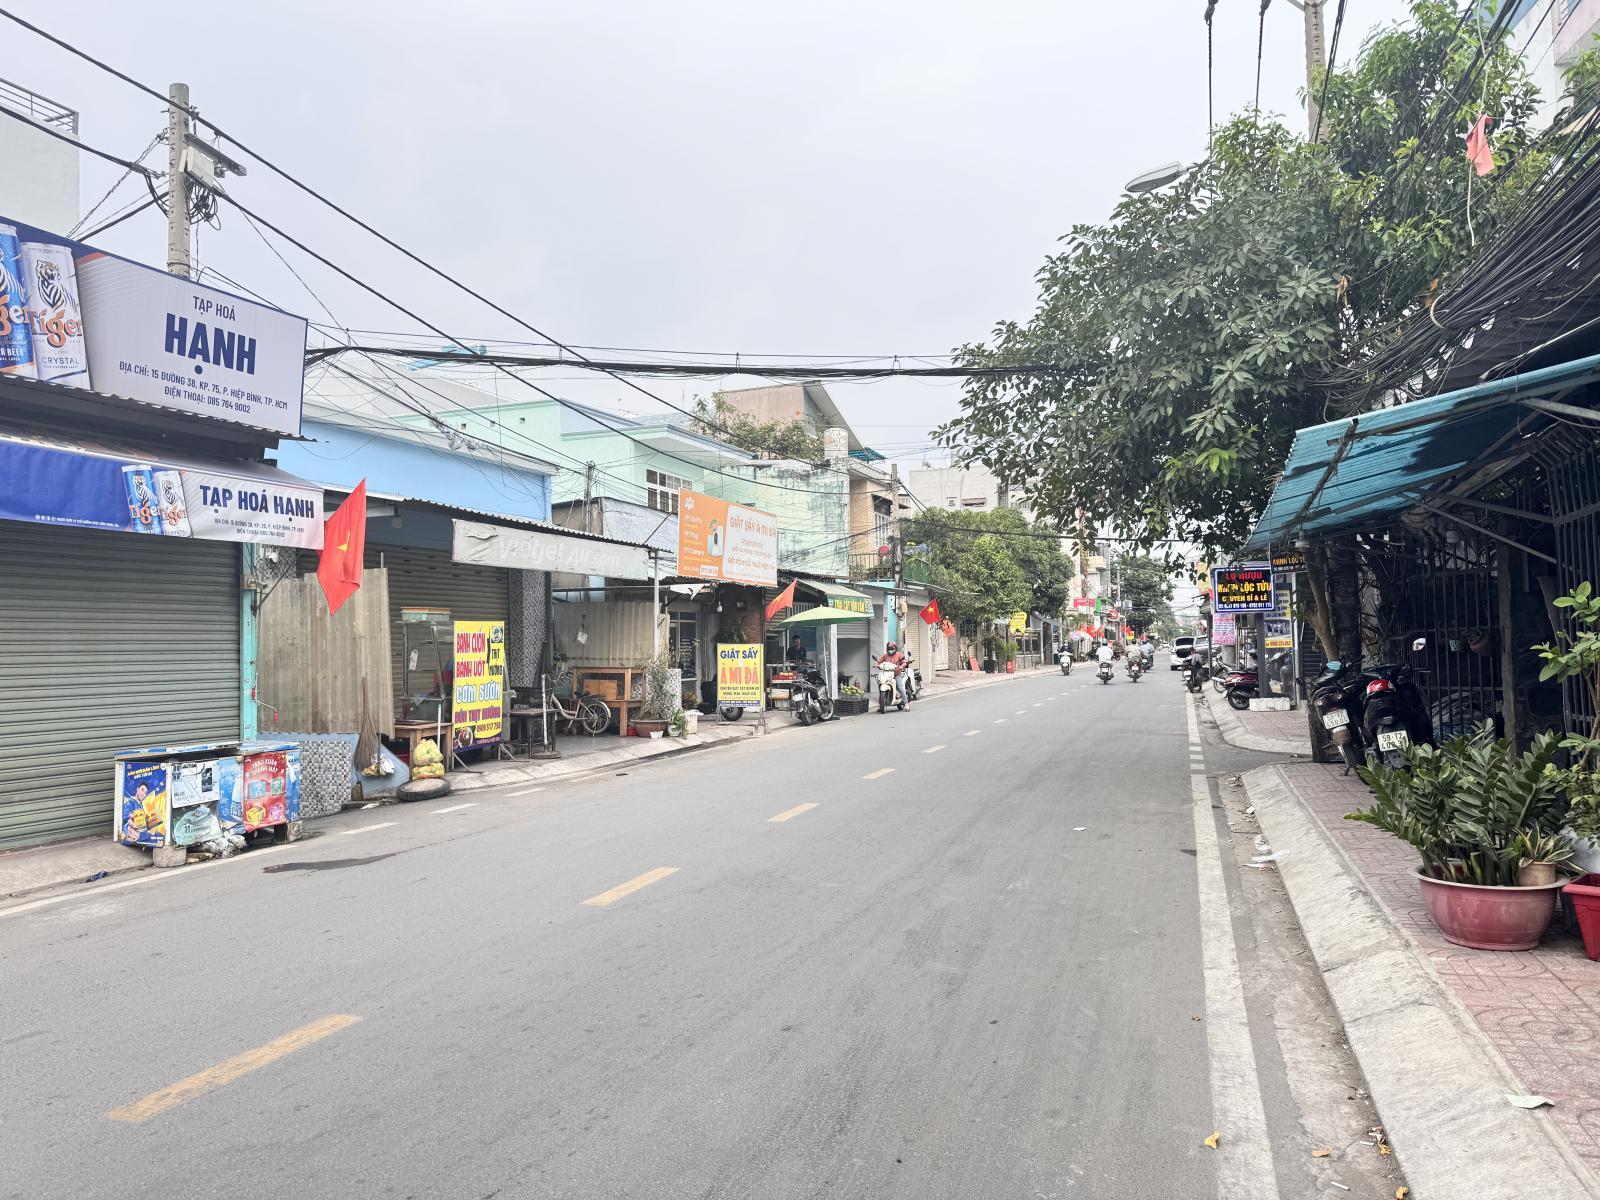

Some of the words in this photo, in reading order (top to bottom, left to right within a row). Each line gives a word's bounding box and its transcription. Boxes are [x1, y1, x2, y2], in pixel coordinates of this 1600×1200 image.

[192, 295, 213, 315] TẠP
[215, 304, 236, 322] HOÁ
[164, 312, 257, 375] HẠNH
[41, 356, 80, 365] CRYSTAL
[119, 361, 132, 374] ĐỊA
[151, 368, 159, 379] 15
[199, 380, 210, 392] KP.
[211, 383, 221, 395] 75,
[222, 386, 229, 396] P.
[230, 388, 246, 401] HIỆP
[264, 396, 274, 407] TP.
[274, 399, 288, 410] HCM
[164, 386, 181, 399] ĐIỆN
[183, 390, 206, 405] THOẠI:
[221, 399, 234, 410] 764
[234, 402, 251, 414] 9002
[199, 484, 233, 514] TẠP
[237, 488, 270, 513] HOÁ
[273, 495, 315, 522] HẠNH
[720, 648, 741, 662] GIẶT
[742, 646, 759, 659] SẤY
[729, 666, 742, 684] MI
